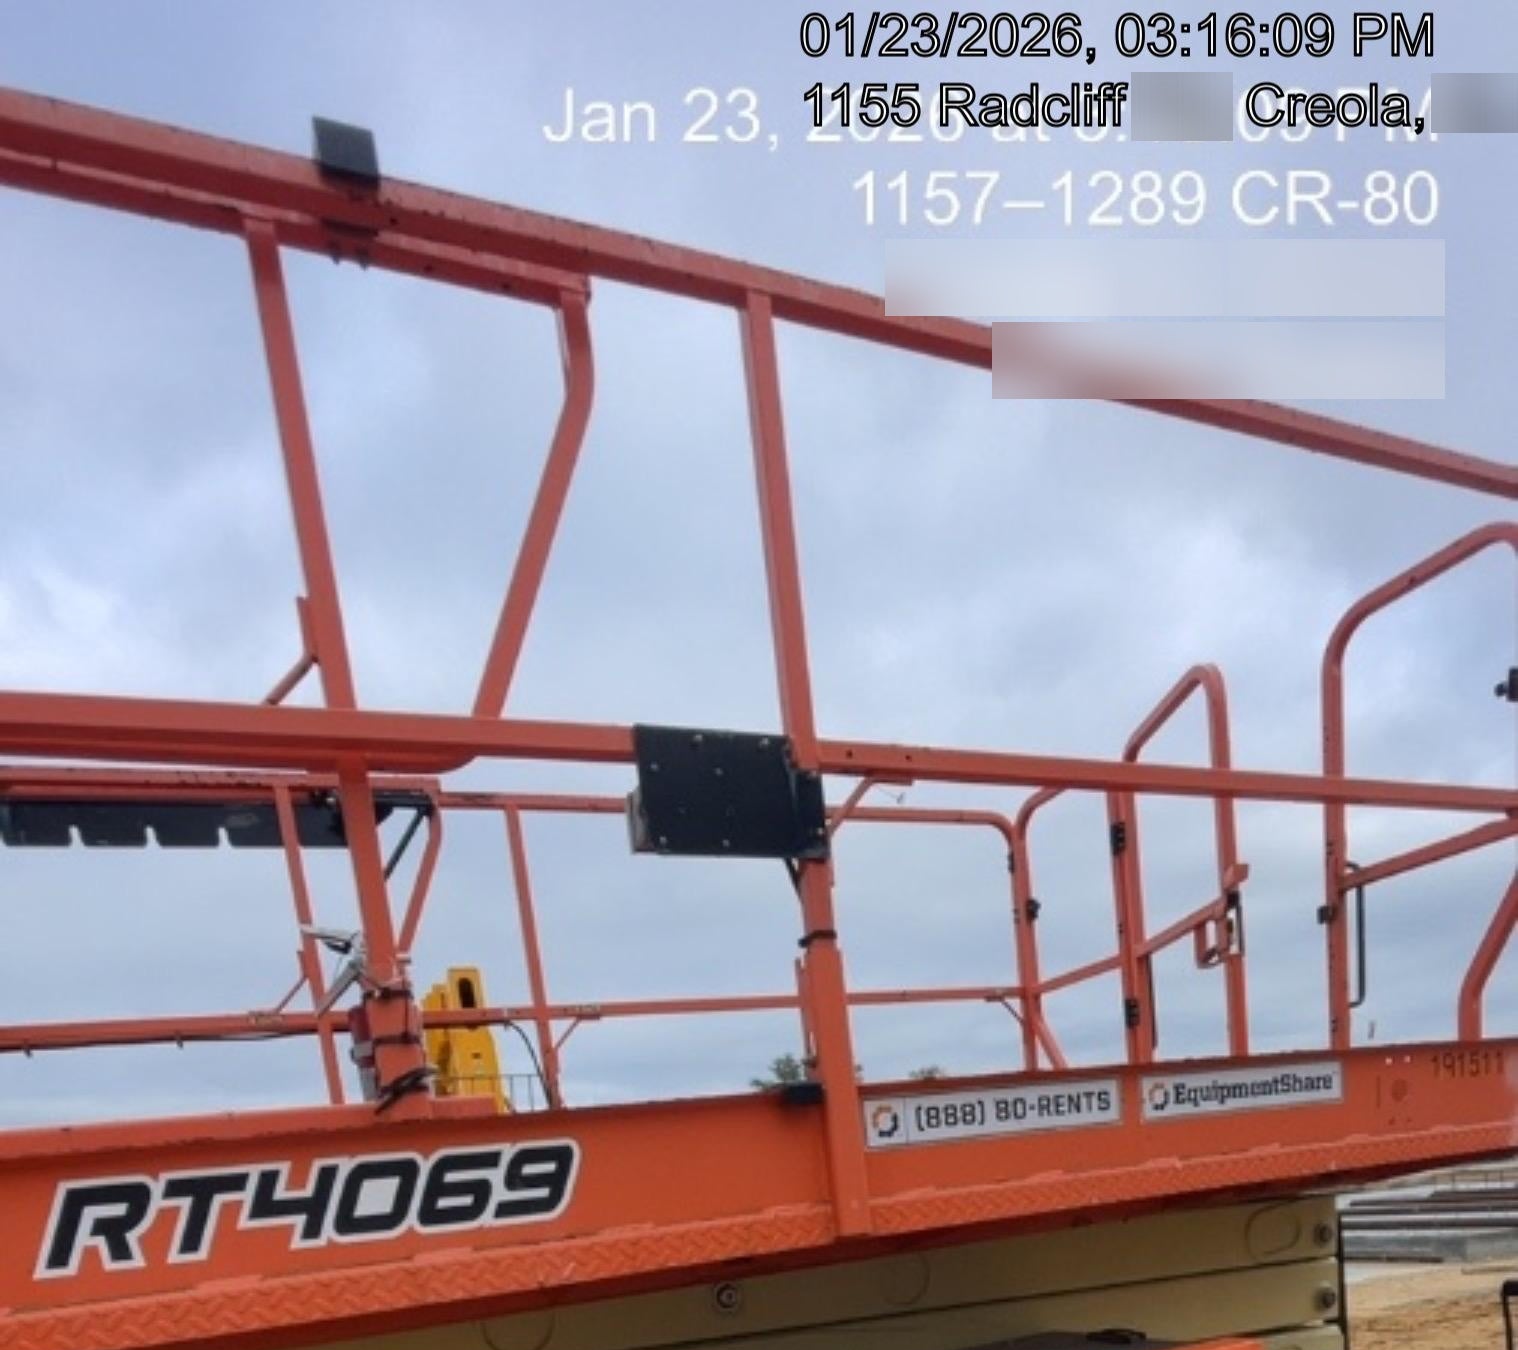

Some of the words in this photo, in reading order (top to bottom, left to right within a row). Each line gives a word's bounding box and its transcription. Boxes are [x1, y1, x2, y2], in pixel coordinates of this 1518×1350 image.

[1173, 1073, 1333, 1107] EquipmentShare
[914, 1100, 985, 1131] (888)
[38, 1142, 576, 1275] RT4069
